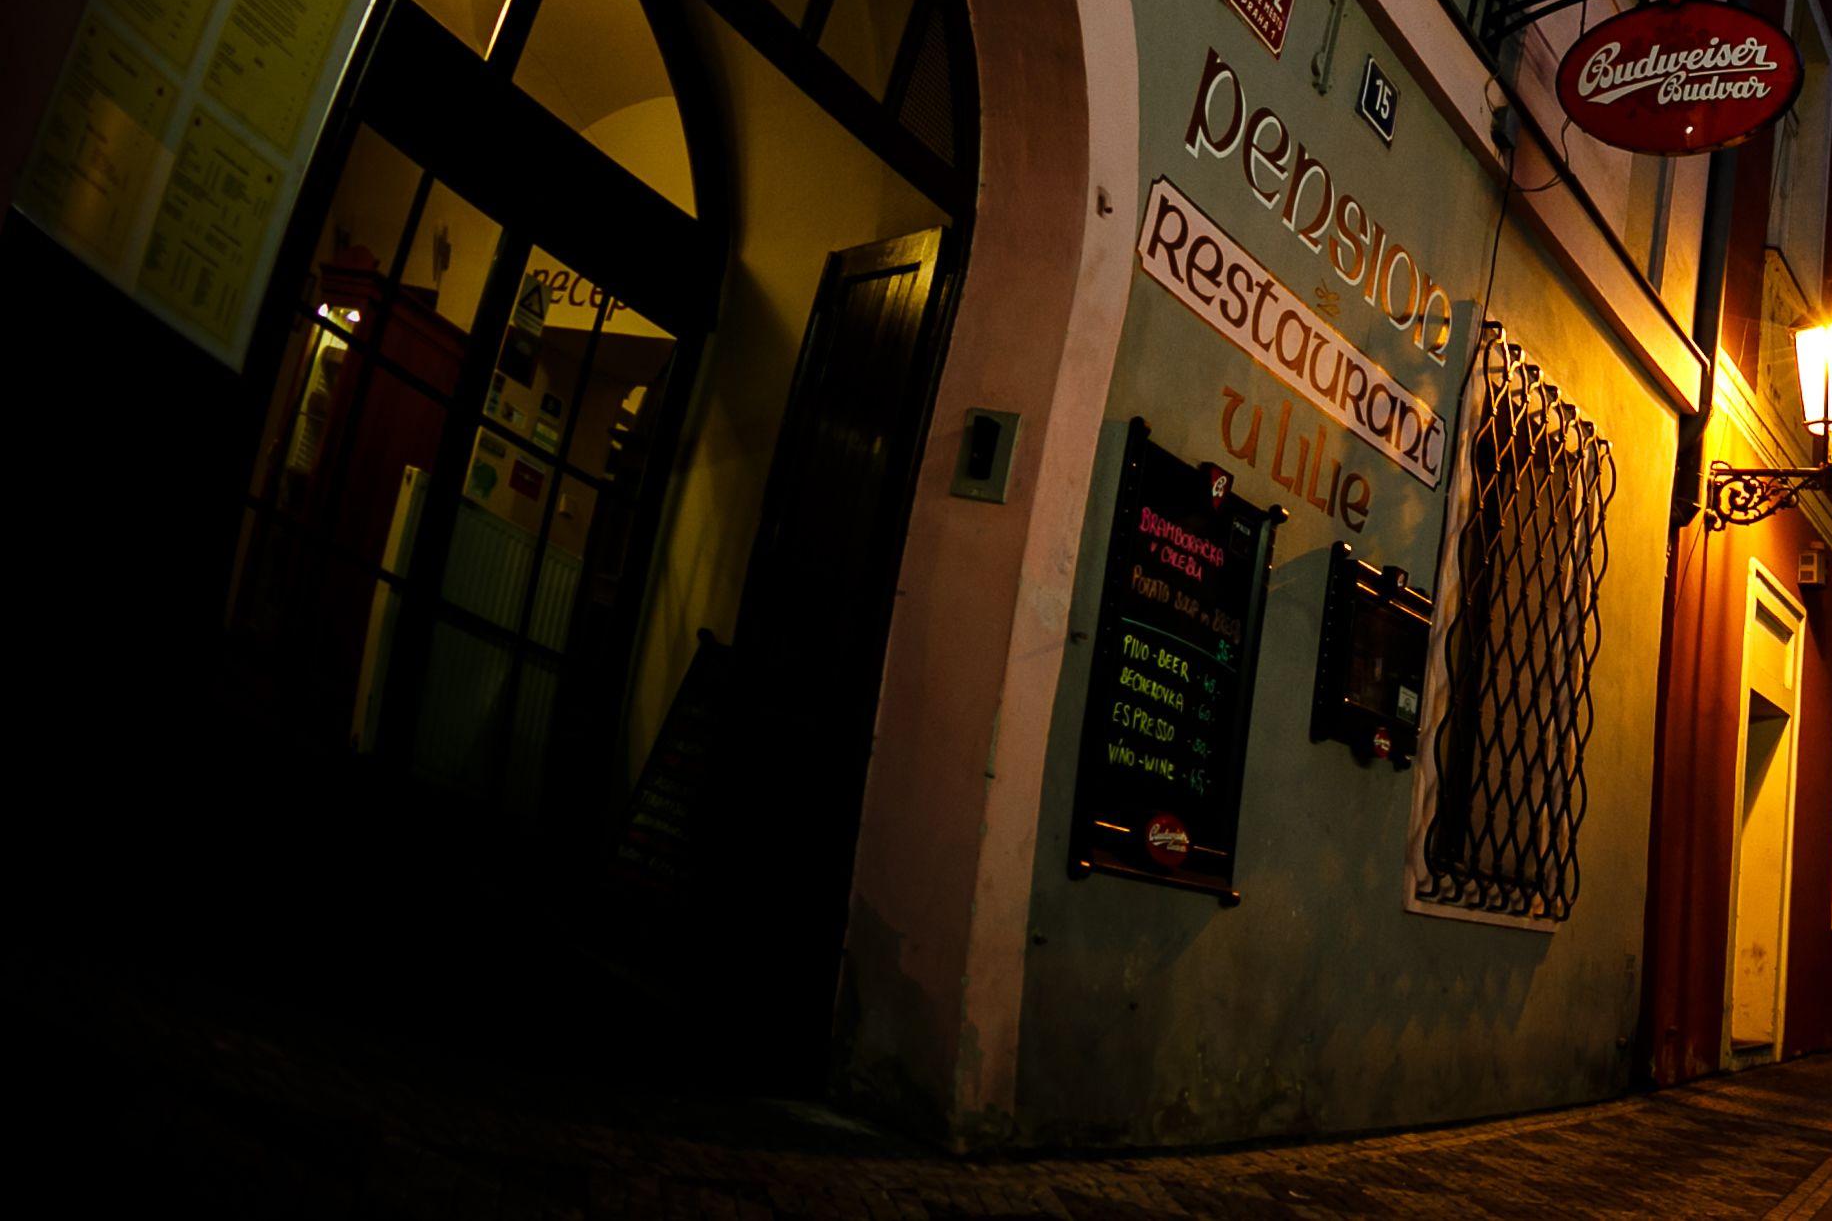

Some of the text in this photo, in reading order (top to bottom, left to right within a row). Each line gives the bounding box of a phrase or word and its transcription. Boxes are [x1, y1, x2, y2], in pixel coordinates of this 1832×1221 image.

[1270, 29, 1277, 40] 1
[1577, 36, 1778, 99] Budweiser
[1657, 70, 1771, 105] Budvar
[1375, 78, 1392, 121] 15
[1184, 46, 1453, 367] pension
[1146, 193, 1442, 477] Restaurant
